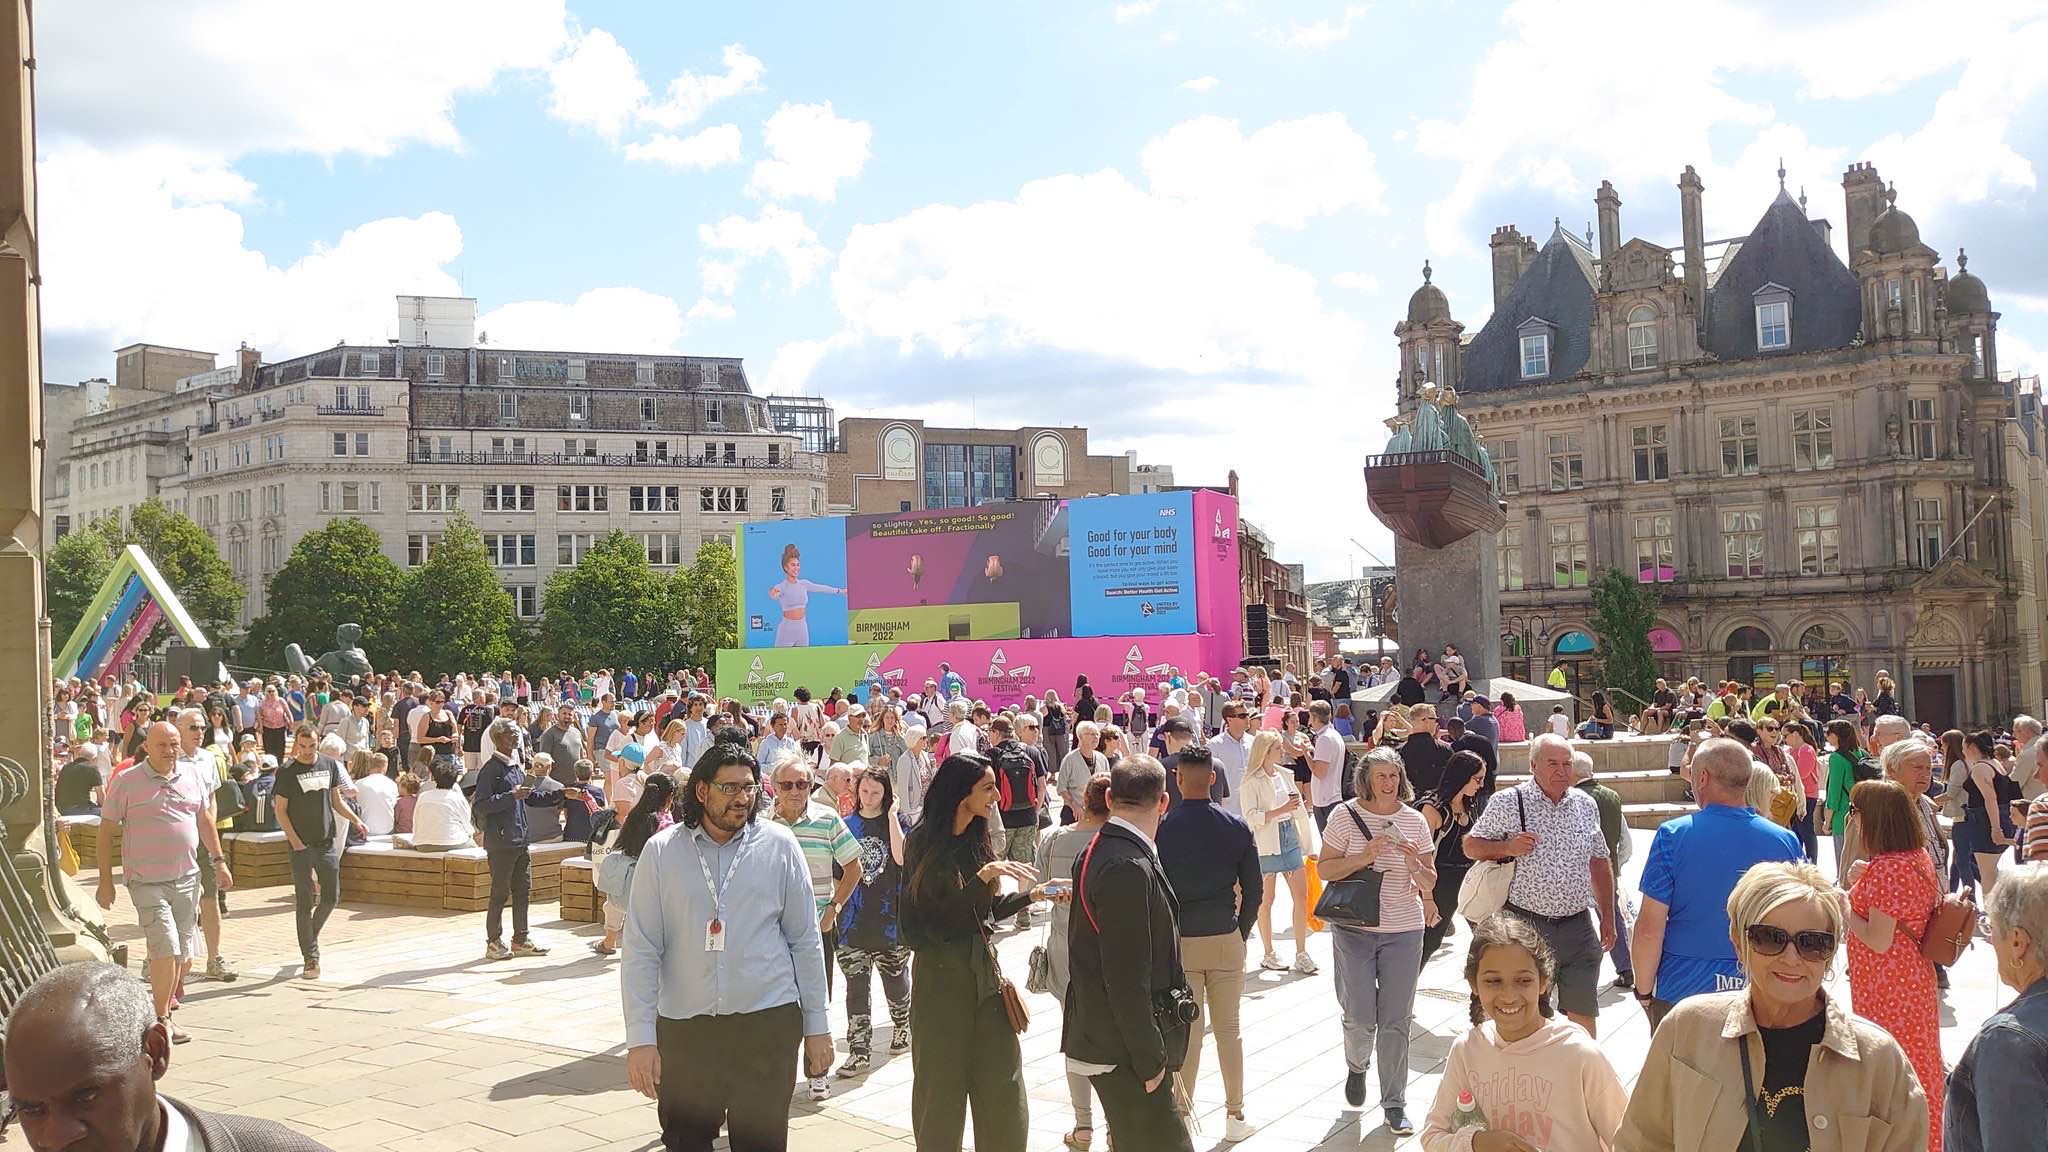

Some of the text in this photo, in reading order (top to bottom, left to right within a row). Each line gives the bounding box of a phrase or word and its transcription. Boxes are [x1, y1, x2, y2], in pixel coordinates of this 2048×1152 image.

[1159, 508, 1176, 517] NHS
[884, 520, 915, 528] slightly.
[951, 515, 975, 524] good!
[990, 512, 1015, 521] good!
[872, 528, 909, 537] Beautiful
[930, 525, 944, 533] off.
[947, 522, 995, 532] Fractionally
[1087, 526, 1177, 543] Good for your body
[1087, 541, 1178, 559] Good for your mind
[856, 621, 910, 632] BIRMINGHAM
[873, 631, 894, 640] 2022
[892, 679, 908, 687] 2022
[978, 676, 1036, 685] BIRMINGHAM 2022
[1112, 675, 1157, 683] BIRMINGHAM
[738, 681, 789, 691] BIRMINGHAM 2022
[993, 684, 1022, 692] FESTIVAL
[751, 689, 776, 697] FESTIVAL
